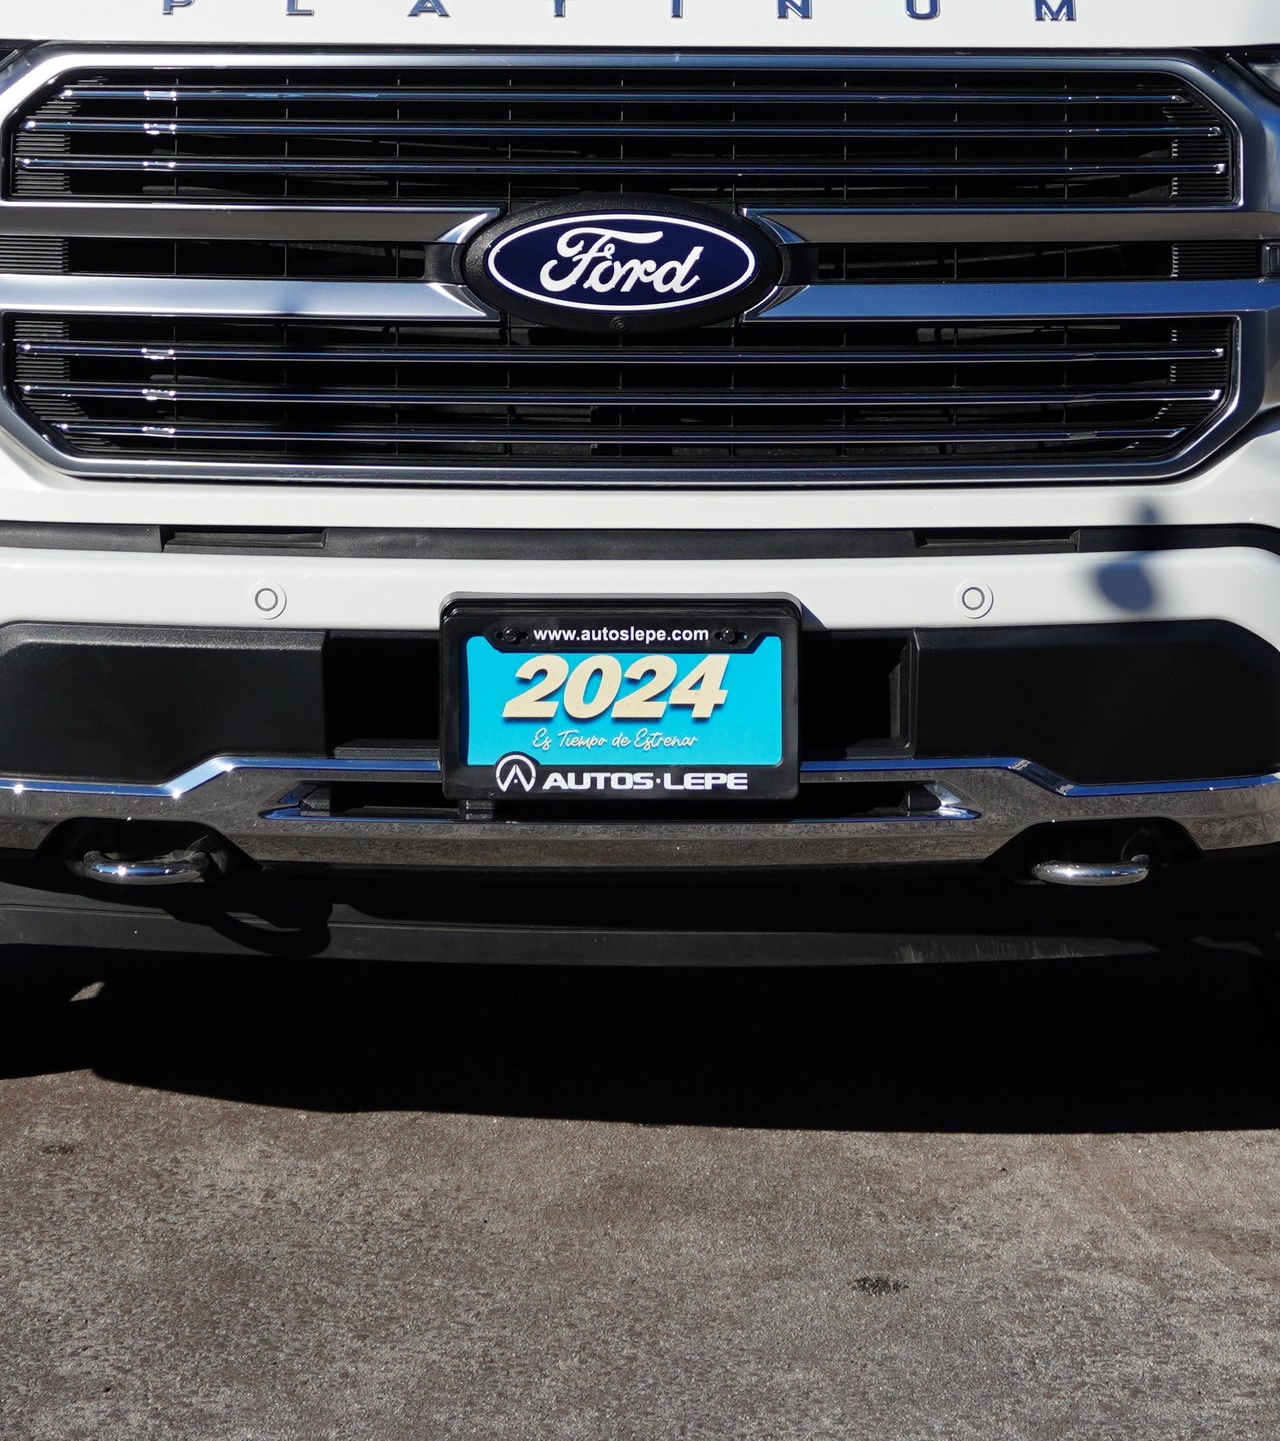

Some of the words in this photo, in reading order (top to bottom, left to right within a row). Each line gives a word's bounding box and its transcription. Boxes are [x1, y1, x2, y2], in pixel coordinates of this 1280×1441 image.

[540, 227, 704, 293] Ford
[533, 626, 709, 645] www.autoslepe.com
[502, 654, 731, 720] 2024
[532, 727, 552, 751] Es
[557, 729, 607, 748] Tiempo
[611, 732, 631, 748] de
[634, 727, 699, 751] Estrenar
